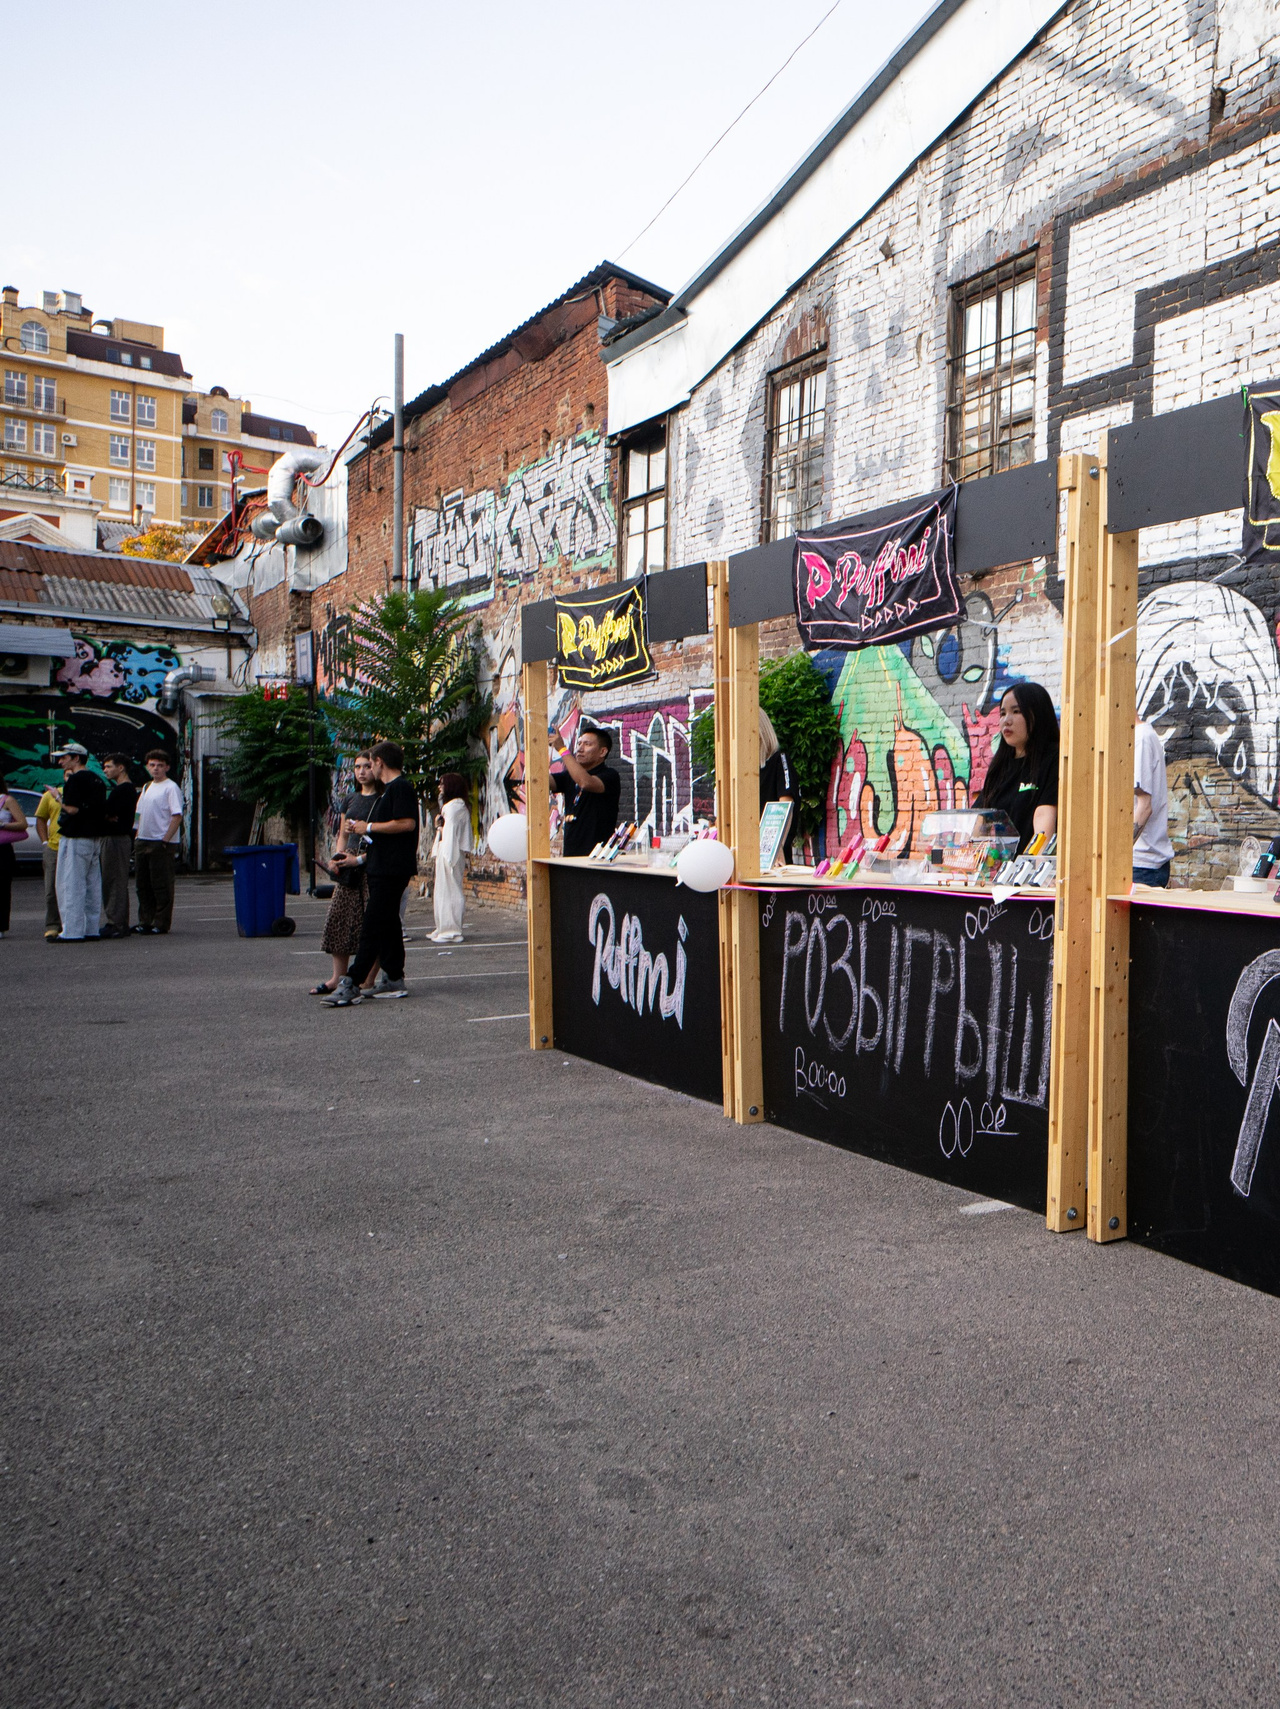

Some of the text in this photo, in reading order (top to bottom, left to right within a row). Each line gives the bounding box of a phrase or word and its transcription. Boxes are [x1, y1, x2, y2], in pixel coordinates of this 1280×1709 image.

[835, 526, 932, 610] Puffmi
[588, 892, 690, 1031] Puffmi
[779, 909, 1054, 1110] РОЗЫГРЫШ
